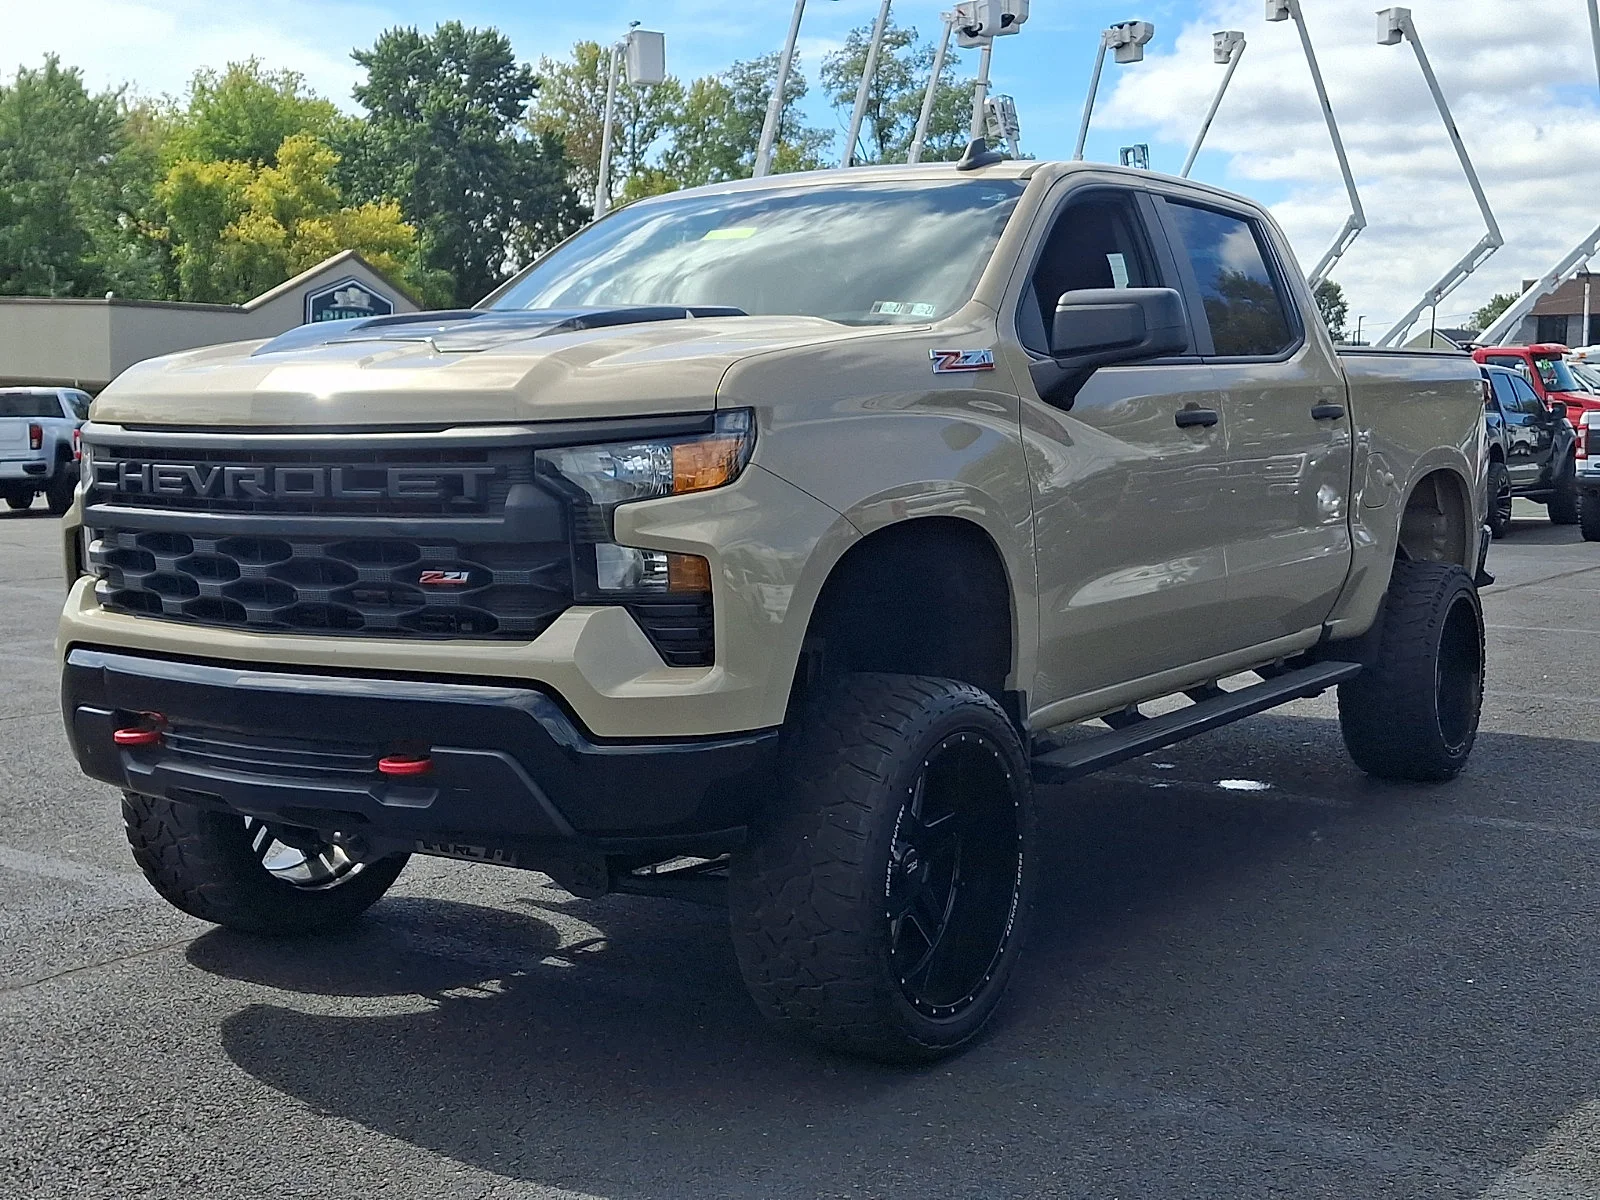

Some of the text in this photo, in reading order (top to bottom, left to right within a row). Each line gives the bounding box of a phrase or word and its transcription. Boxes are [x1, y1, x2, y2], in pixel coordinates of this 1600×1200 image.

[929, 348, 995, 374] Z71
[91, 461, 496, 498] CHEVROLET
[419, 570, 469, 584] Z71
